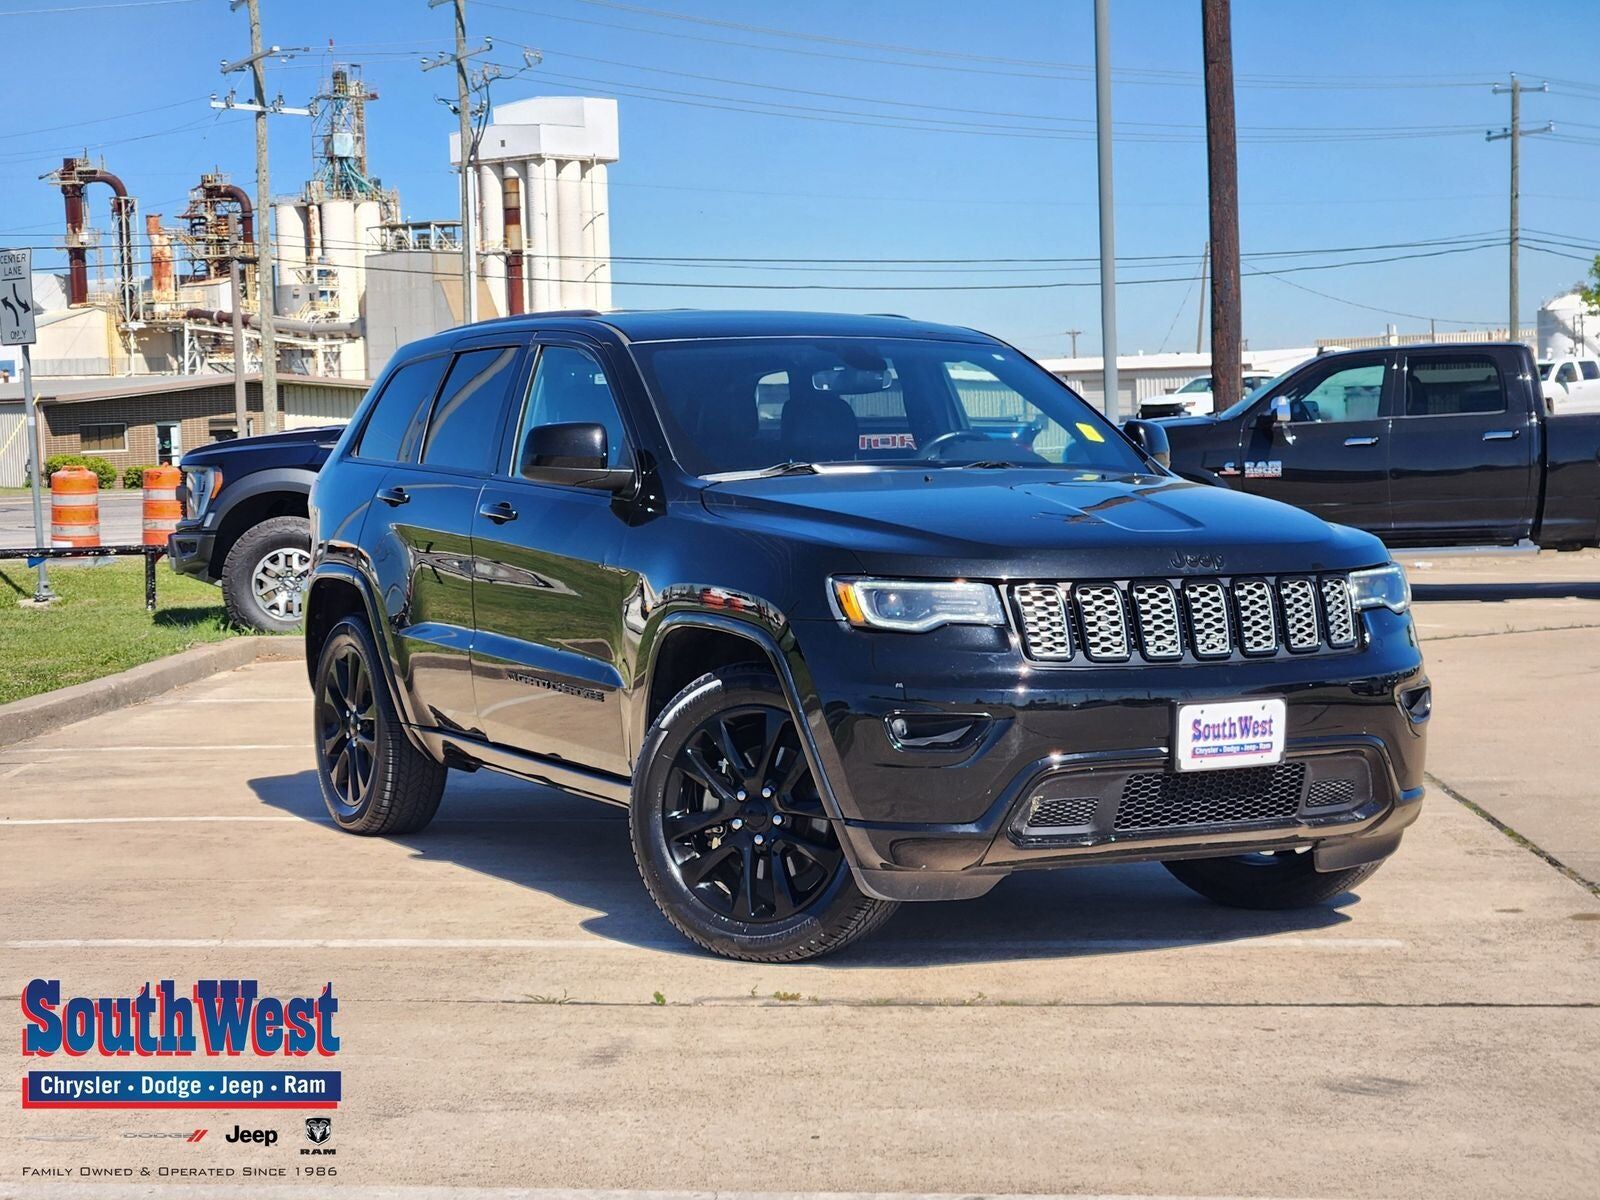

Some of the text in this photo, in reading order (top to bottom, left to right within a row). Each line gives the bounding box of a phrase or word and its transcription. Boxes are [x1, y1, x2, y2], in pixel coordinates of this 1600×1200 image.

[0, 253, 26, 264] CENTER
[4, 266, 22, 276] LANE
[10, 330, 27, 341] ONLY
[1170, 550, 1225, 571] Jeep
[1191, 715, 1274, 742] SouthWest
[1195, 742, 1271, 755] Chrysler Dodge Jeep Ram
